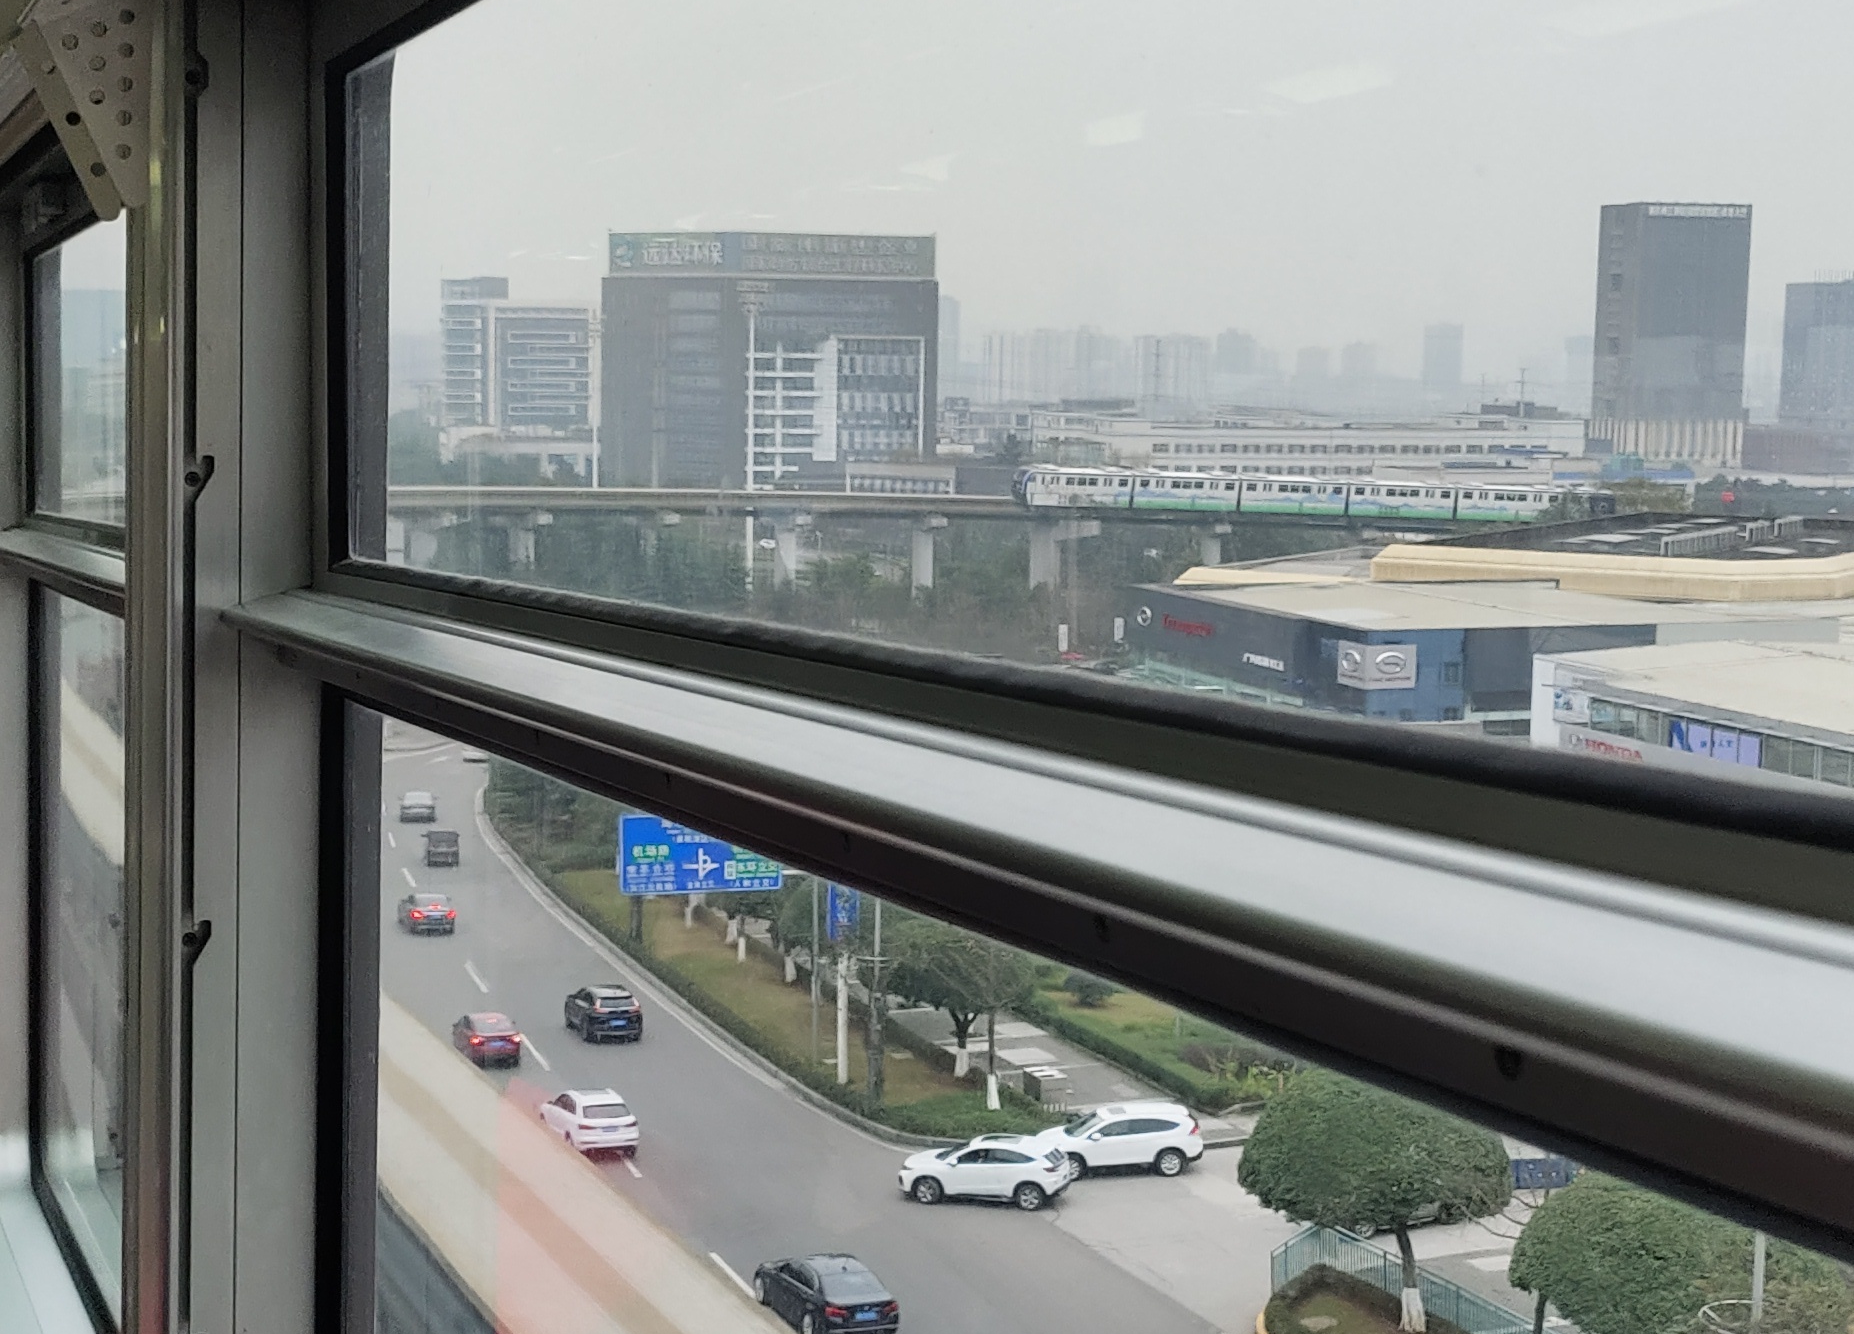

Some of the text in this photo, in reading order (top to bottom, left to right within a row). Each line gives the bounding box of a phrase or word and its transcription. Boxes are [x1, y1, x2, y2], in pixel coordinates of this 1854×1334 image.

[641, 241, 724, 266] 远达环保
[1584, 738, 1643, 762] HONDA
